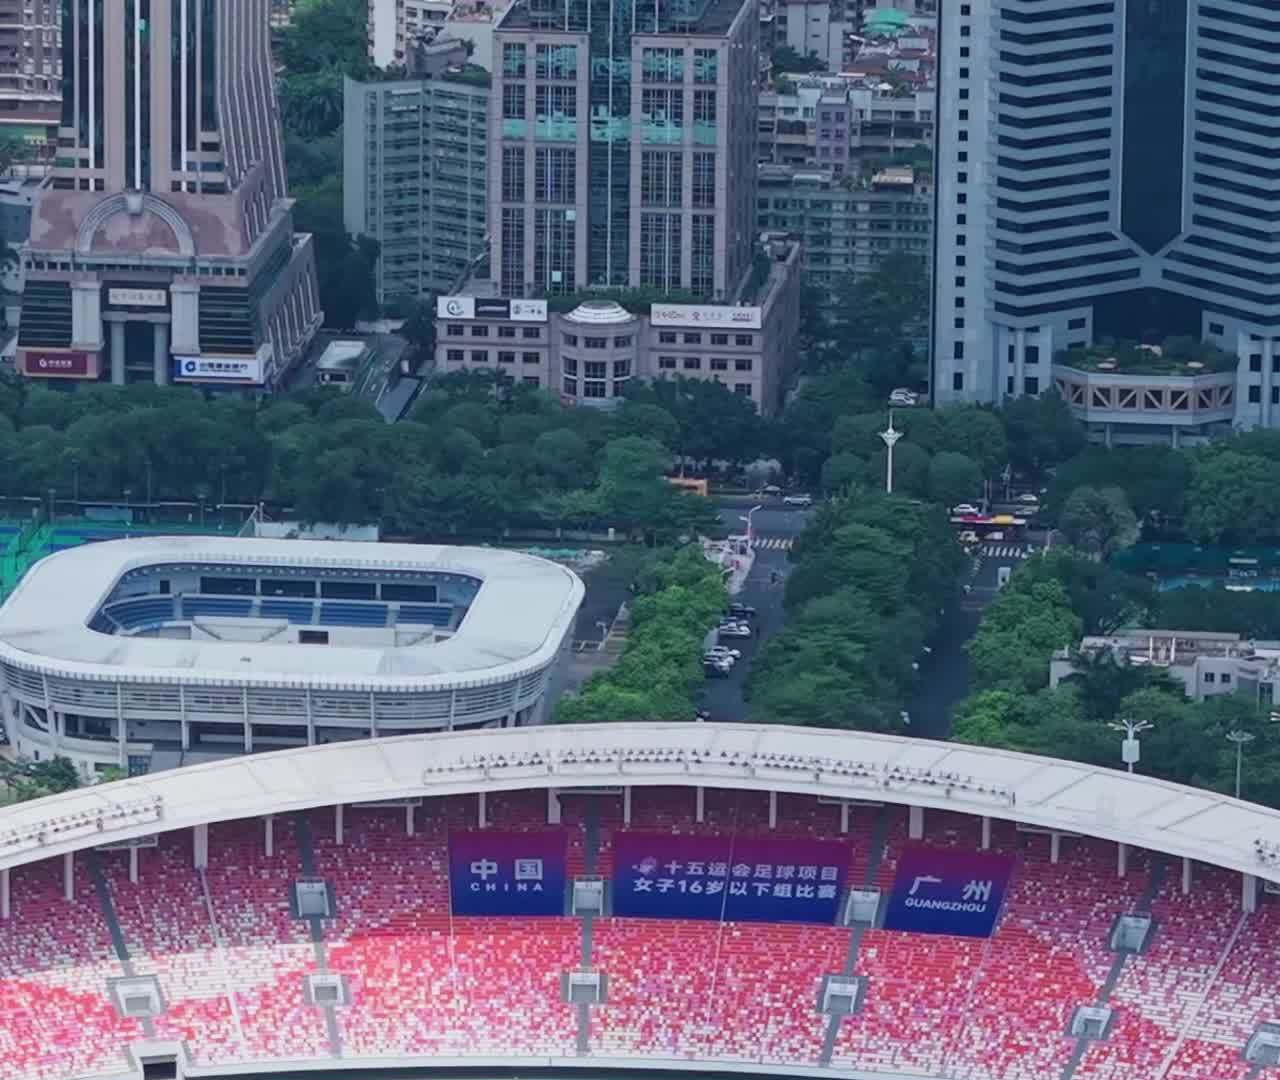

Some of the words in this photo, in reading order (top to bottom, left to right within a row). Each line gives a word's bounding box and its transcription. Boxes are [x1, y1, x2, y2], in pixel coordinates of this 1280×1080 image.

[470, 858, 543, 880] 中国
[664, 860, 839, 881] 十五运会足球项目
[470, 881, 543, 892] CHINA
[632, 876, 837, 899] 女子16岁以下组比赛
[908, 875, 993, 902] 广州
[904, 897, 987, 913] GUANGZHOU
